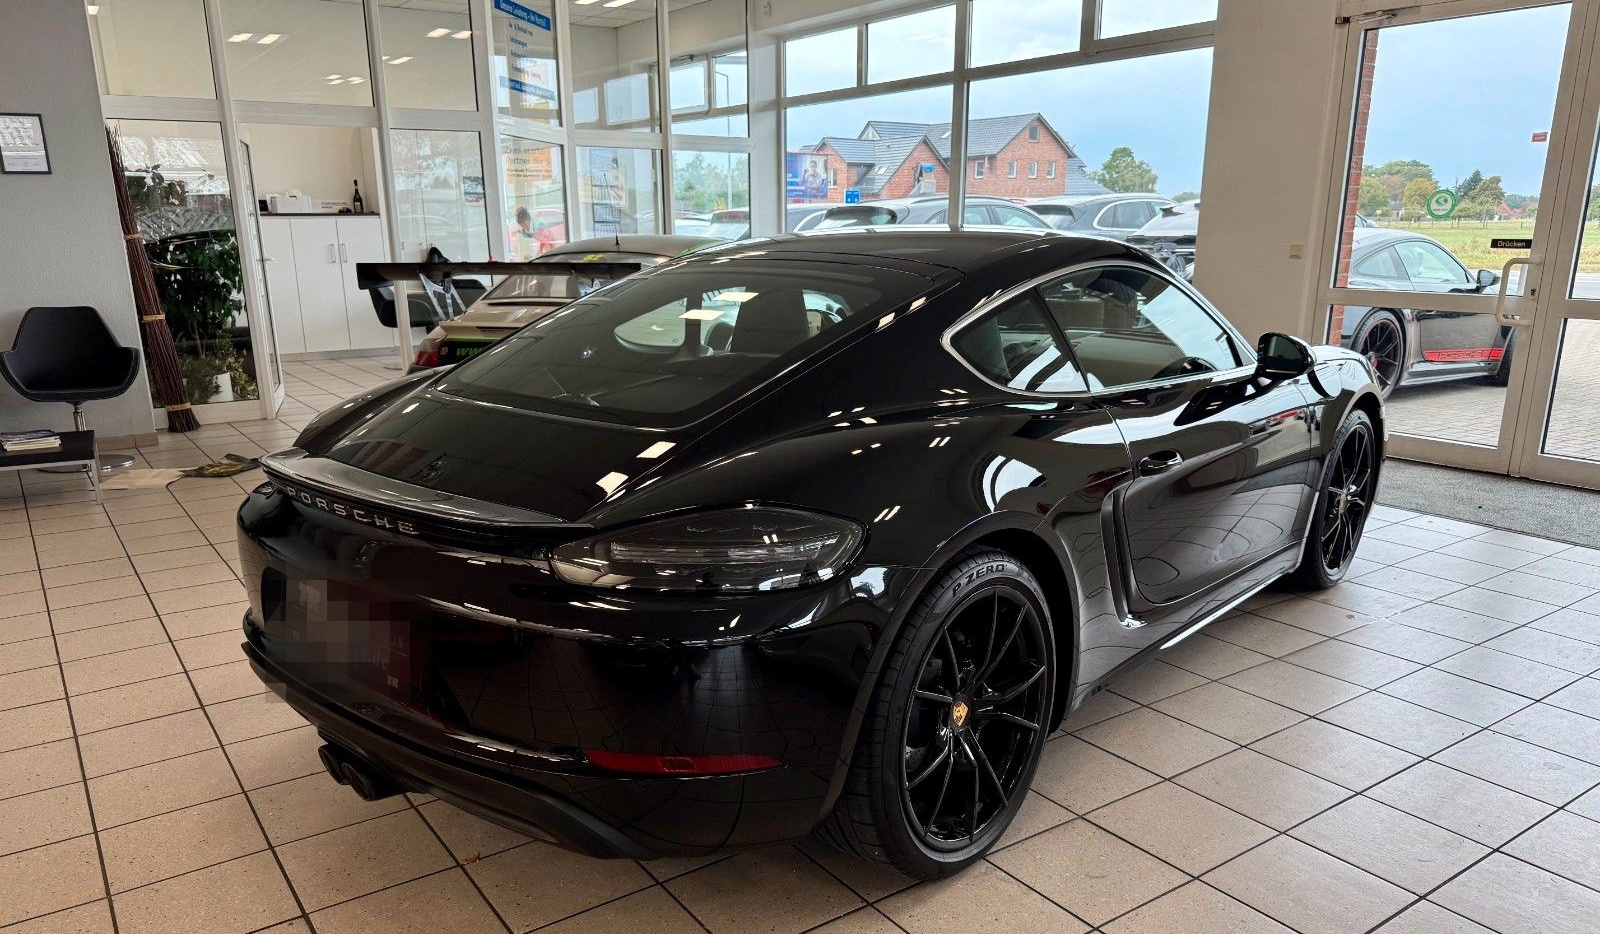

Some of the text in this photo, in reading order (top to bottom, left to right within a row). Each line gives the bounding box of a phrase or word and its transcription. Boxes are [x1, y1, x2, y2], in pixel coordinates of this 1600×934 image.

[1497, 240, 1526, 248] Drücken
[287, 487, 421, 535] PORSCHE
[952, 563, 1006, 598] P ZERO
